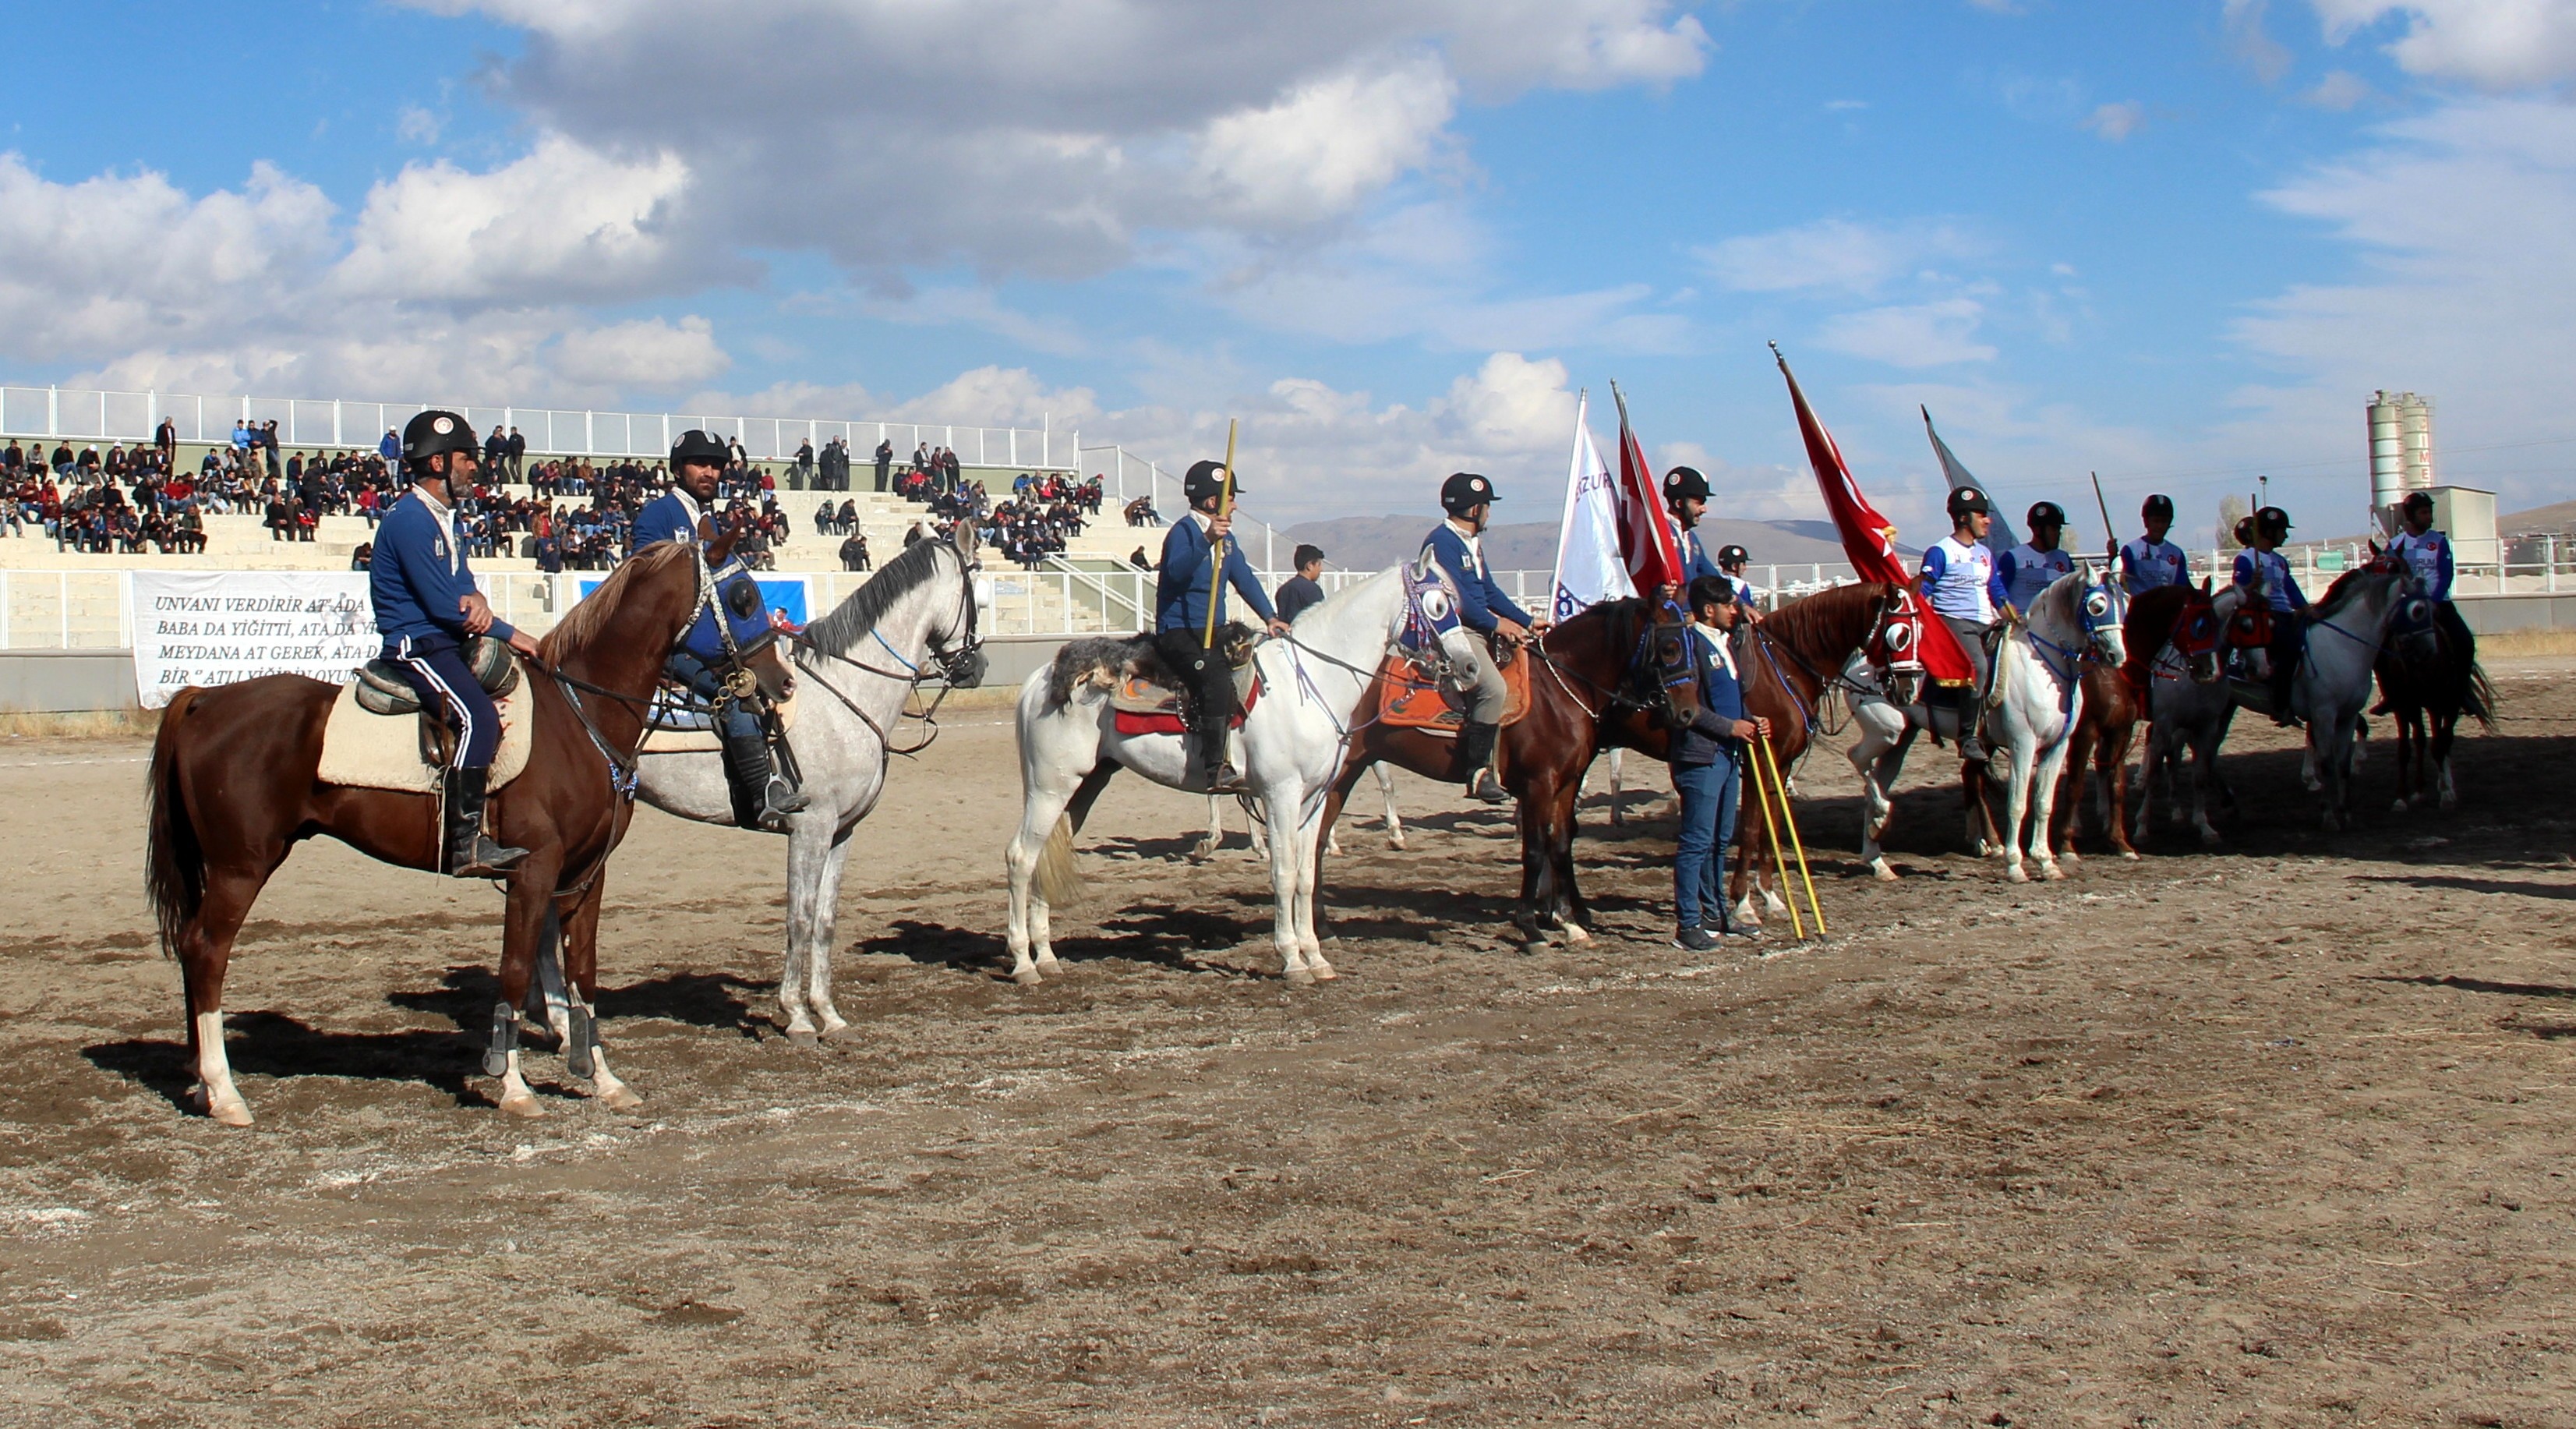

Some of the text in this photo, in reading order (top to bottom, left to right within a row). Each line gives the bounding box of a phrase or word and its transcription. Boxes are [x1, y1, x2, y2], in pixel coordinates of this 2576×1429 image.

[156, 596, 221, 611] UNVANI
[225, 595, 302, 612] VERDİRİR
[156, 621, 198, 635] BABA
[203, 622, 226, 636] DA
[231, 619, 295, 638] YİĞİTTİ,
[298, 623, 329, 636] ATA
[333, 623, 355, 636] DA
[158, 645, 240, 660] MEYDANA
[244, 646, 267, 660] AT
[270, 646, 327, 662] GEREK,
[330, 646, 362, 659] ATA
[159, 666, 189, 684] BİR
